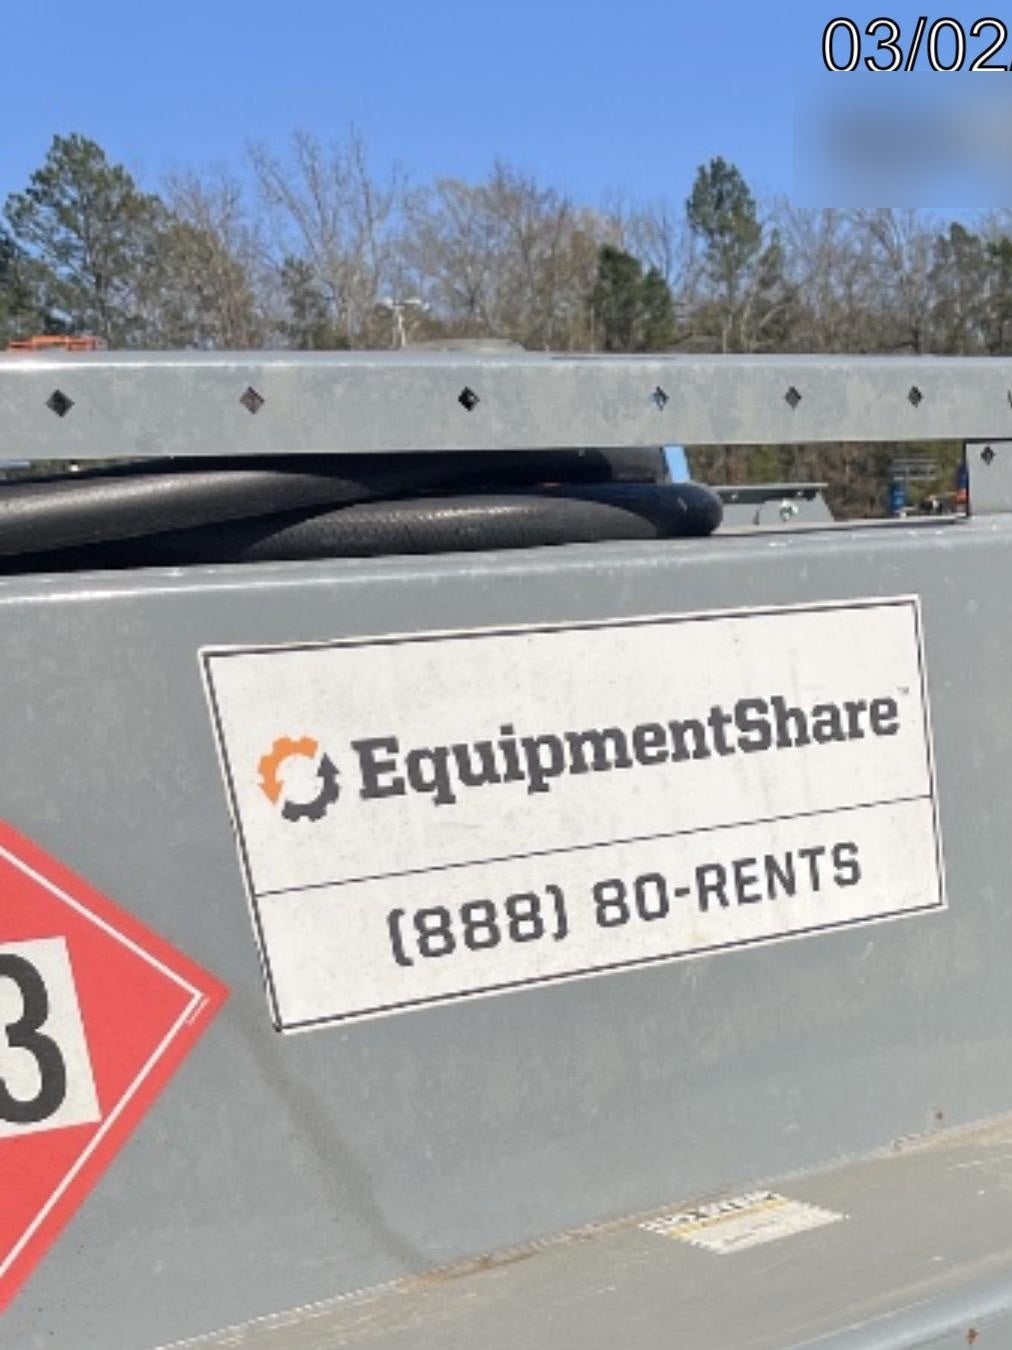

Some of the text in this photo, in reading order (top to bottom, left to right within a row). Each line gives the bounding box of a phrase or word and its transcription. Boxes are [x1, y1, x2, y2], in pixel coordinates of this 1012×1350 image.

[387, 841, 863, 966] (888) 80-RENTS
[0, 953, 67, 1124] 3
